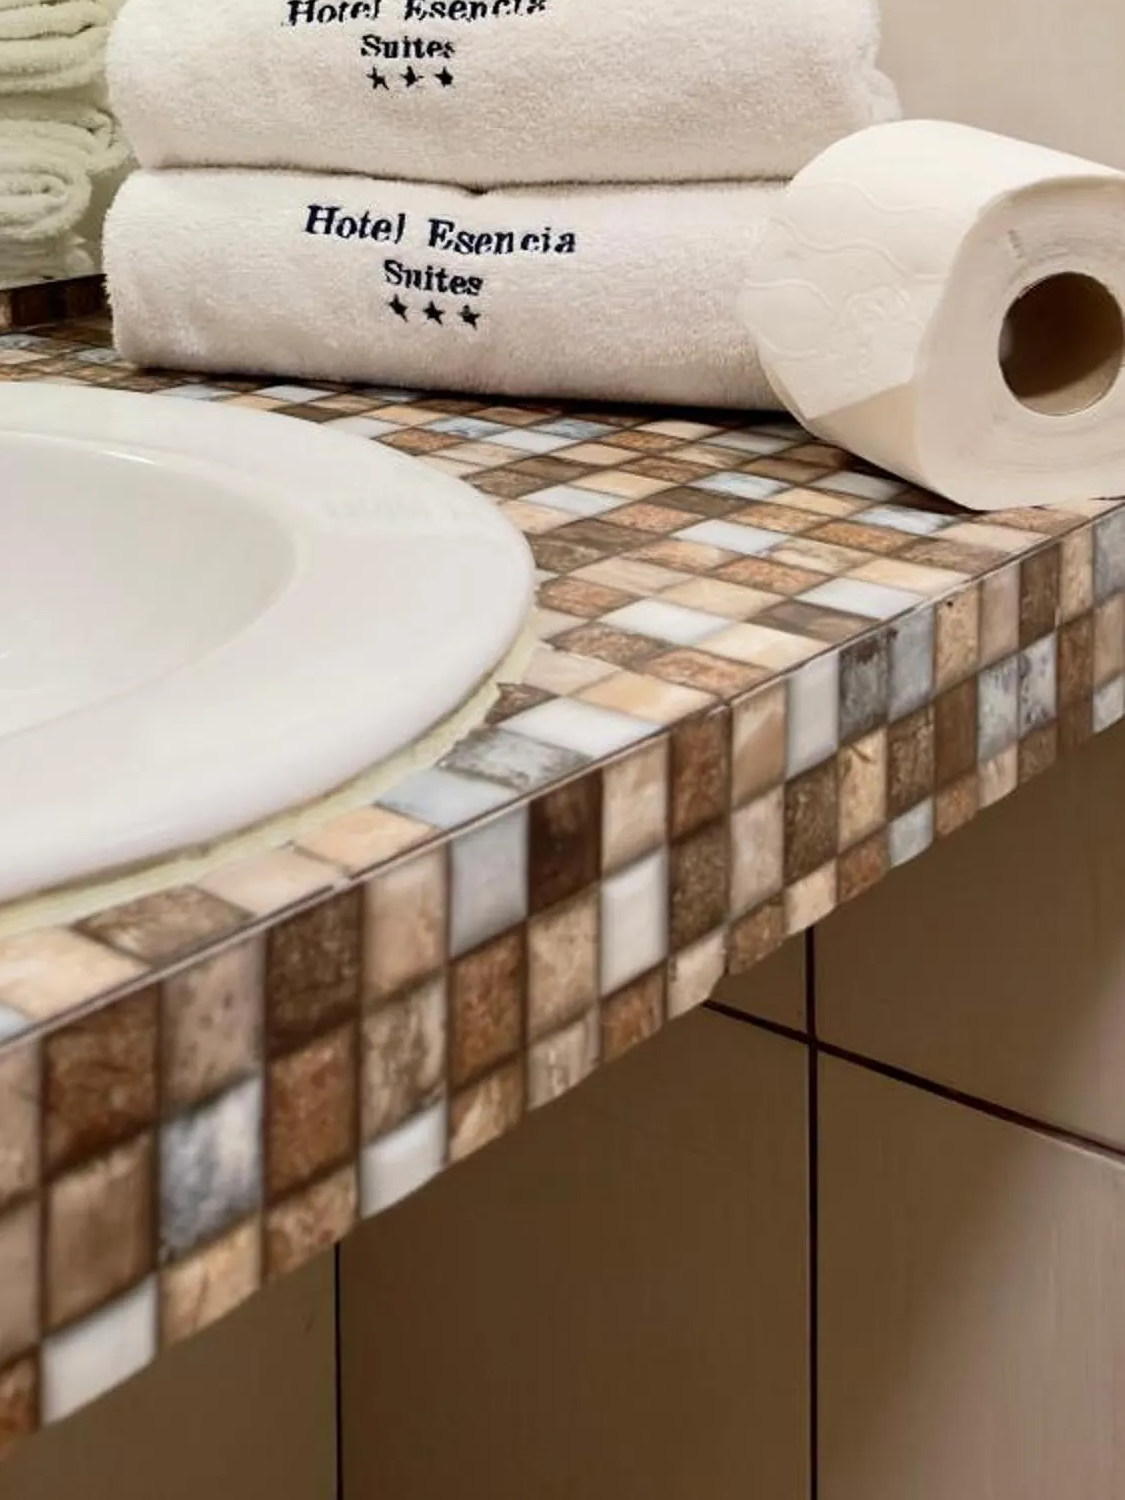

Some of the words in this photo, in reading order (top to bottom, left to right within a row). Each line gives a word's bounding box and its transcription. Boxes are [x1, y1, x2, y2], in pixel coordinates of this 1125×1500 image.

[360, 33, 455, 59] Suites
[304, 204, 406, 244] Hotel
[427, 217, 577, 255] Esencia
[383, 259, 484, 296] Suites
